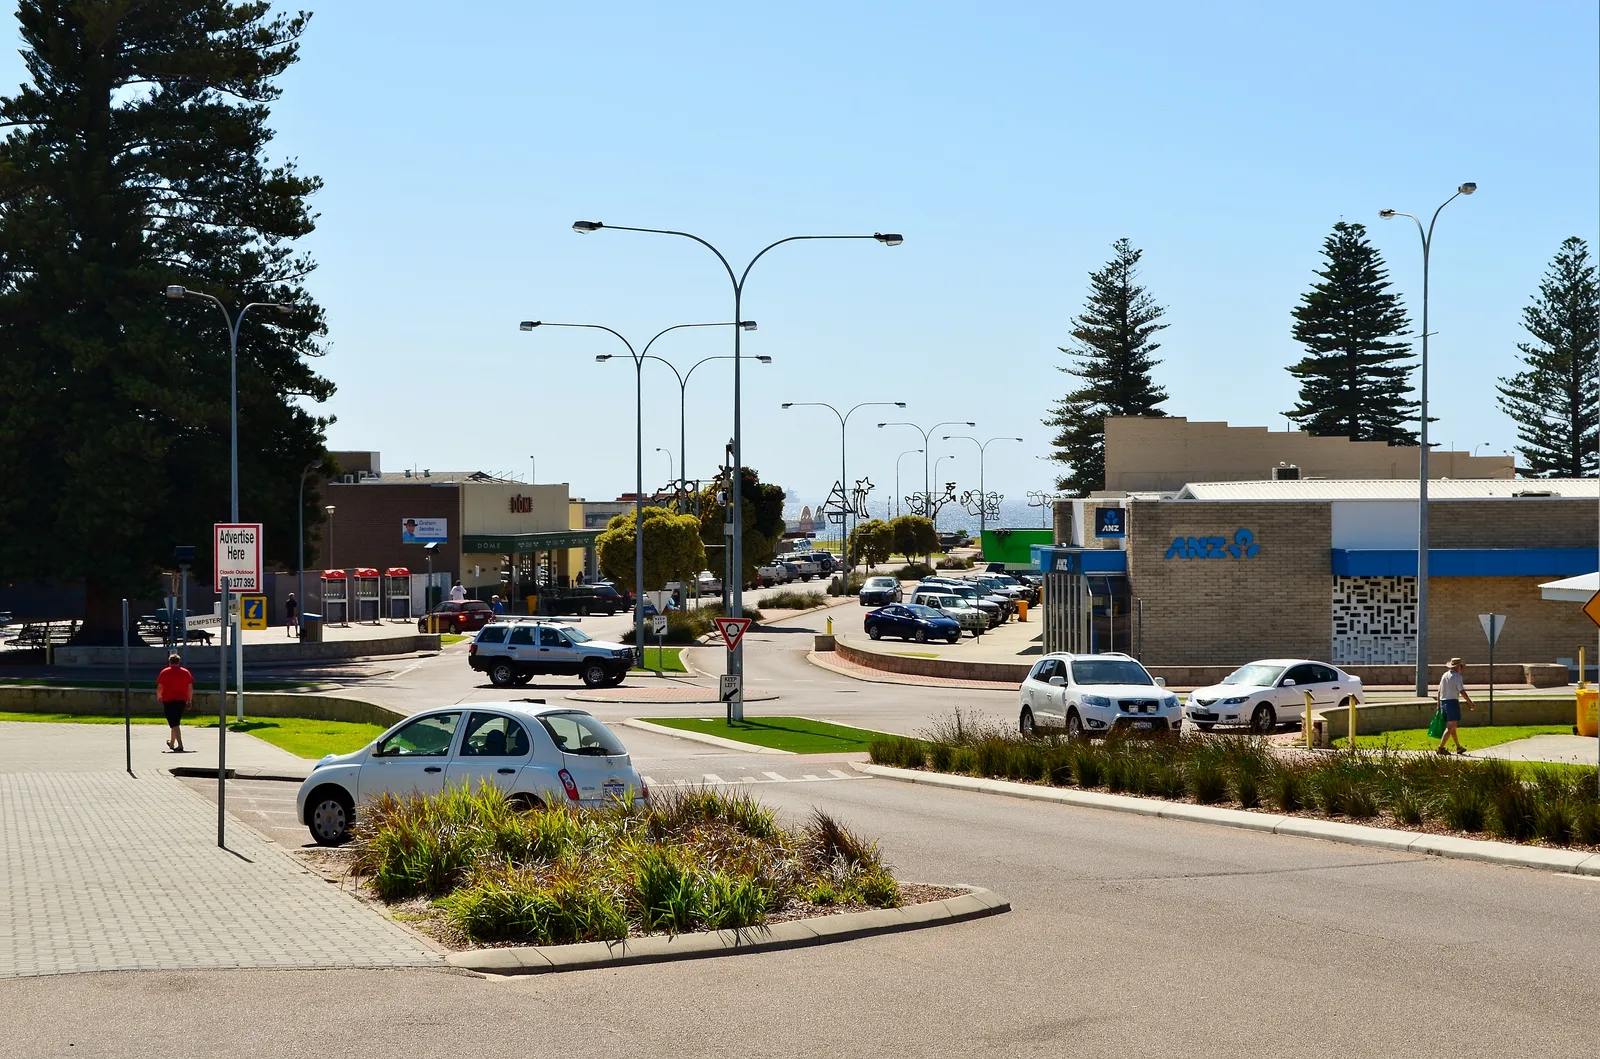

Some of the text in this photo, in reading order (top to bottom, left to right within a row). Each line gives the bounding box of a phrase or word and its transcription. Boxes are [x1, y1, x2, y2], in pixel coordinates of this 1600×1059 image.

[220, 530, 254, 544] Advertise
[227, 546, 245, 560] Here
[1164, 536, 1227, 559] ANZ
[1056, 558, 1068, 571] ANZ
[233, 577, 243, 587] 177
[243, 577, 255, 587] 392
[188, 617, 222, 627] DEMPSTER
